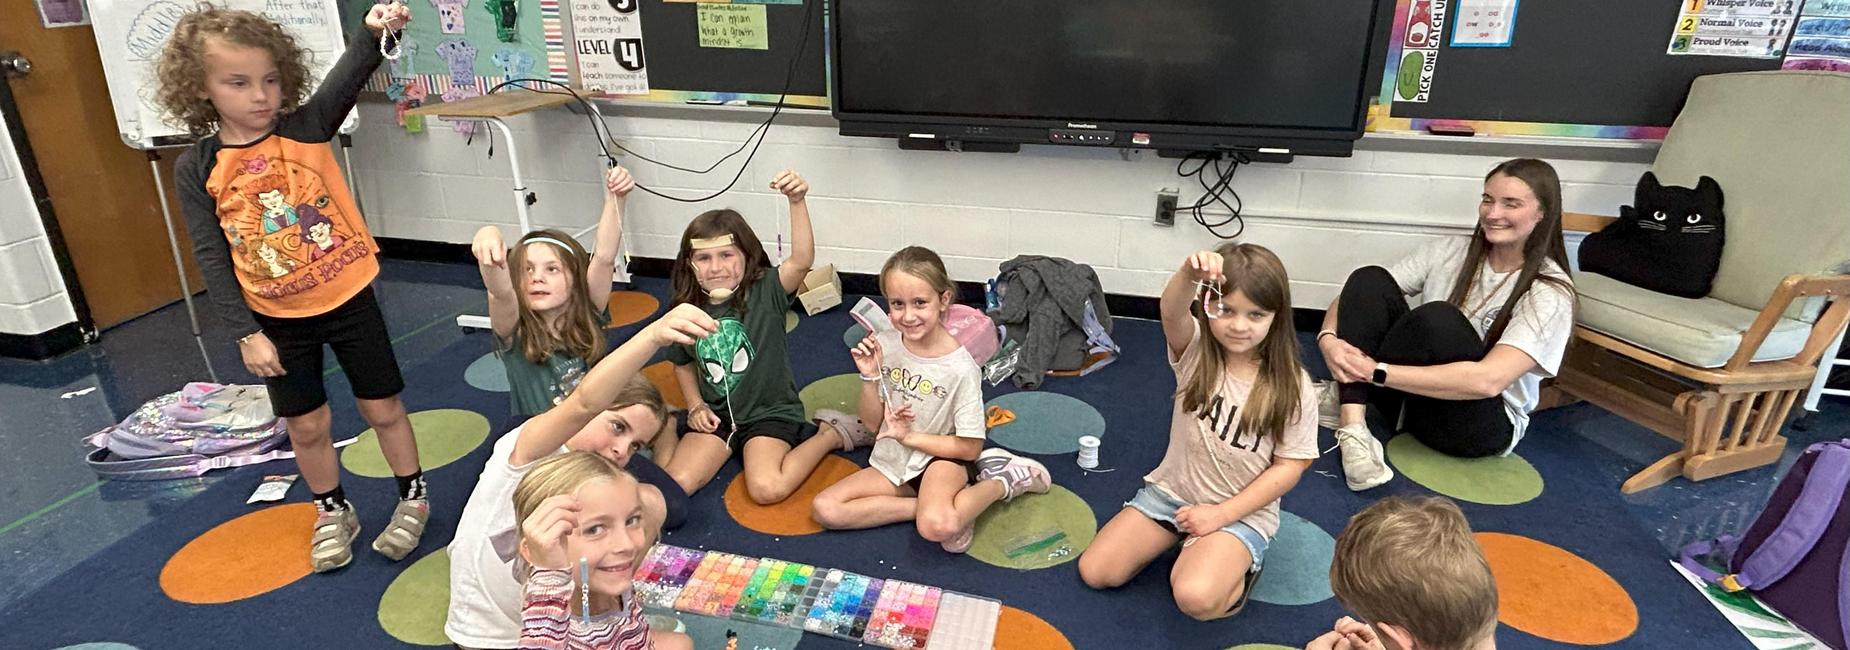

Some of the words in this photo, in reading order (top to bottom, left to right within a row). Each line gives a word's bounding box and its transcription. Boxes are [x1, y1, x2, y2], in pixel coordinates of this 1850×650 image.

[1435, 0, 1447, 10] U
[1690, 0, 1697, 11] 1
[1706, 0, 1746, 8] Whisper
[1748, 0, 1775, 8] Voice
[600, 15, 612, 25] my
[1681, 18, 1694, 31] 2
[1699, 18, 1736, 28] Normal
[1738, 19, 1764, 28] Voice
[1429, 12, 1444, 49] CATCH
[1693, 37, 1721, 46] Proud
[1723, 38, 1749, 47] Voice
[577, 39, 612, 55] LEVEL
[620, 41, 639, 68] 4
[1424, 51, 1437, 73] ONE
[1417, 76, 1432, 102] PICK
[319, 241, 370, 284] POCUS
